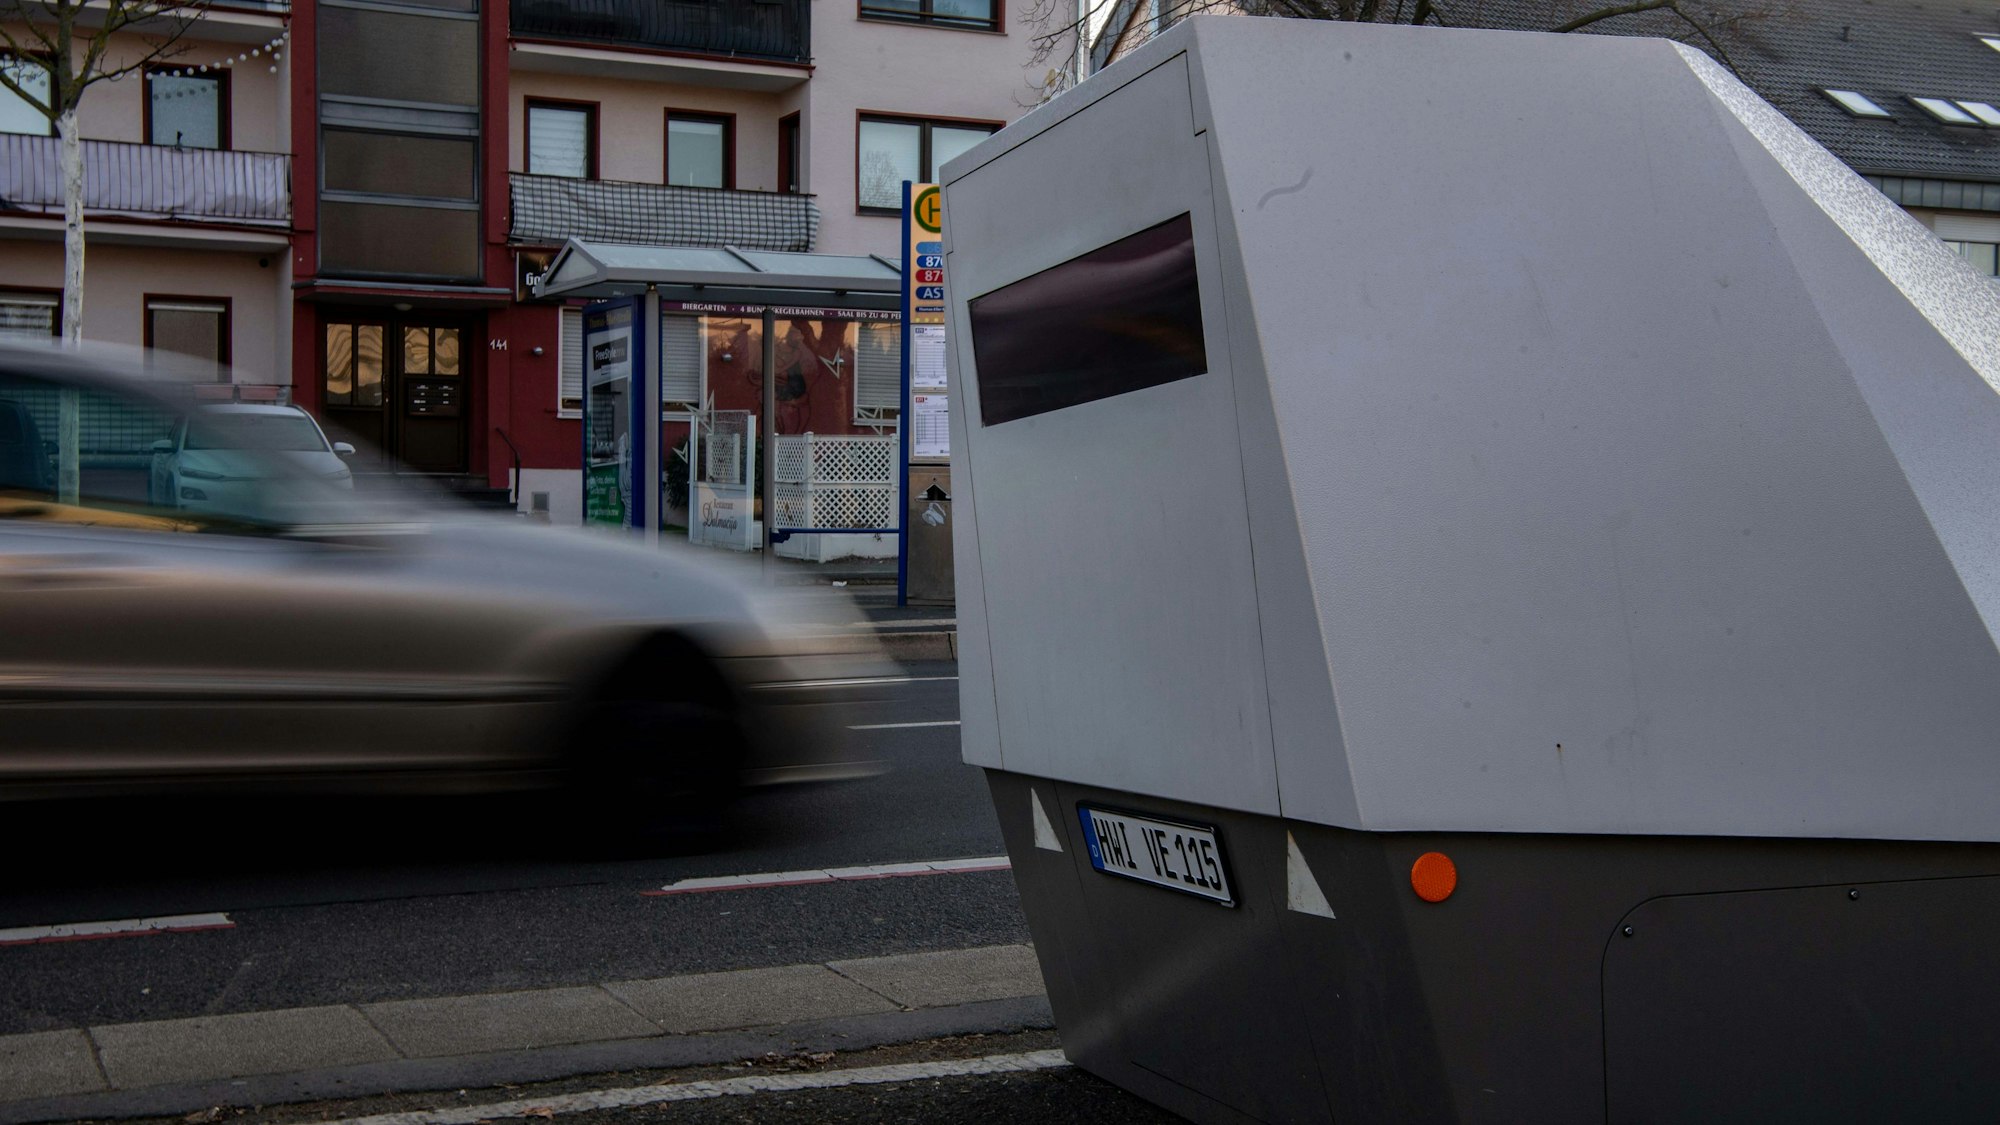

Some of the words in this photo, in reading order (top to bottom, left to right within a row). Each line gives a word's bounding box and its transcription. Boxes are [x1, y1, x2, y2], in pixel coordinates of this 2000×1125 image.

[925, 256, 943, 267] 87
[925, 270, 943, 282] 87
[682, 302, 726, 312] BIERGARTEN
[740, 305, 745, 313] 4
[837, 310, 854, 318] SAAL
[869, 311, 878, 319] ZU
[489, 339, 508, 351] 141
[1093, 817, 1137, 869] HWI
